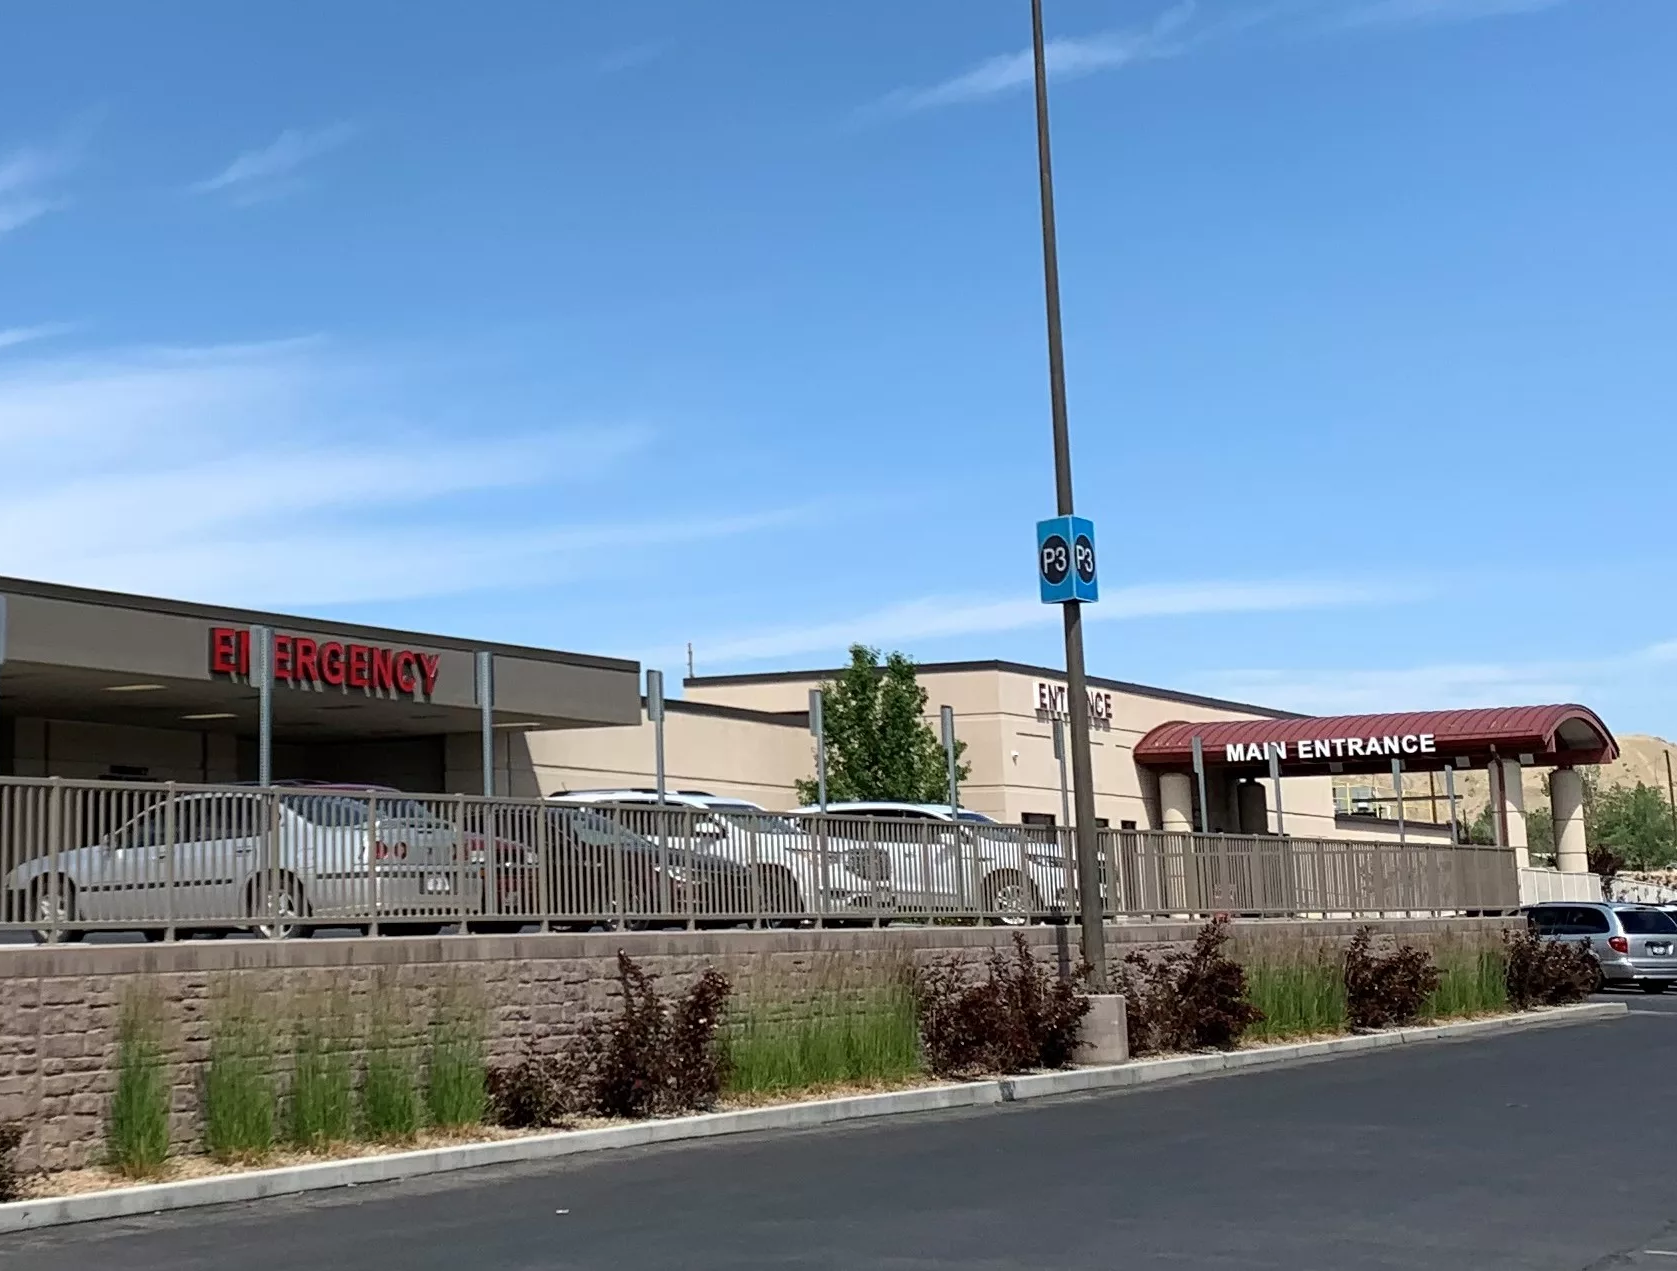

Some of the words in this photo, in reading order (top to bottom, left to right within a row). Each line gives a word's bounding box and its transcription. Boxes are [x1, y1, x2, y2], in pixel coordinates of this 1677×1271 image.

[1042, 546, 1067, 574] P3
[1076, 545, 1093, 573] P3
[1036, 682, 1113, 719] ENTNCE
[1226, 741, 1287, 762] MAIN
[1298, 734, 1436, 759] ENTRANCE
